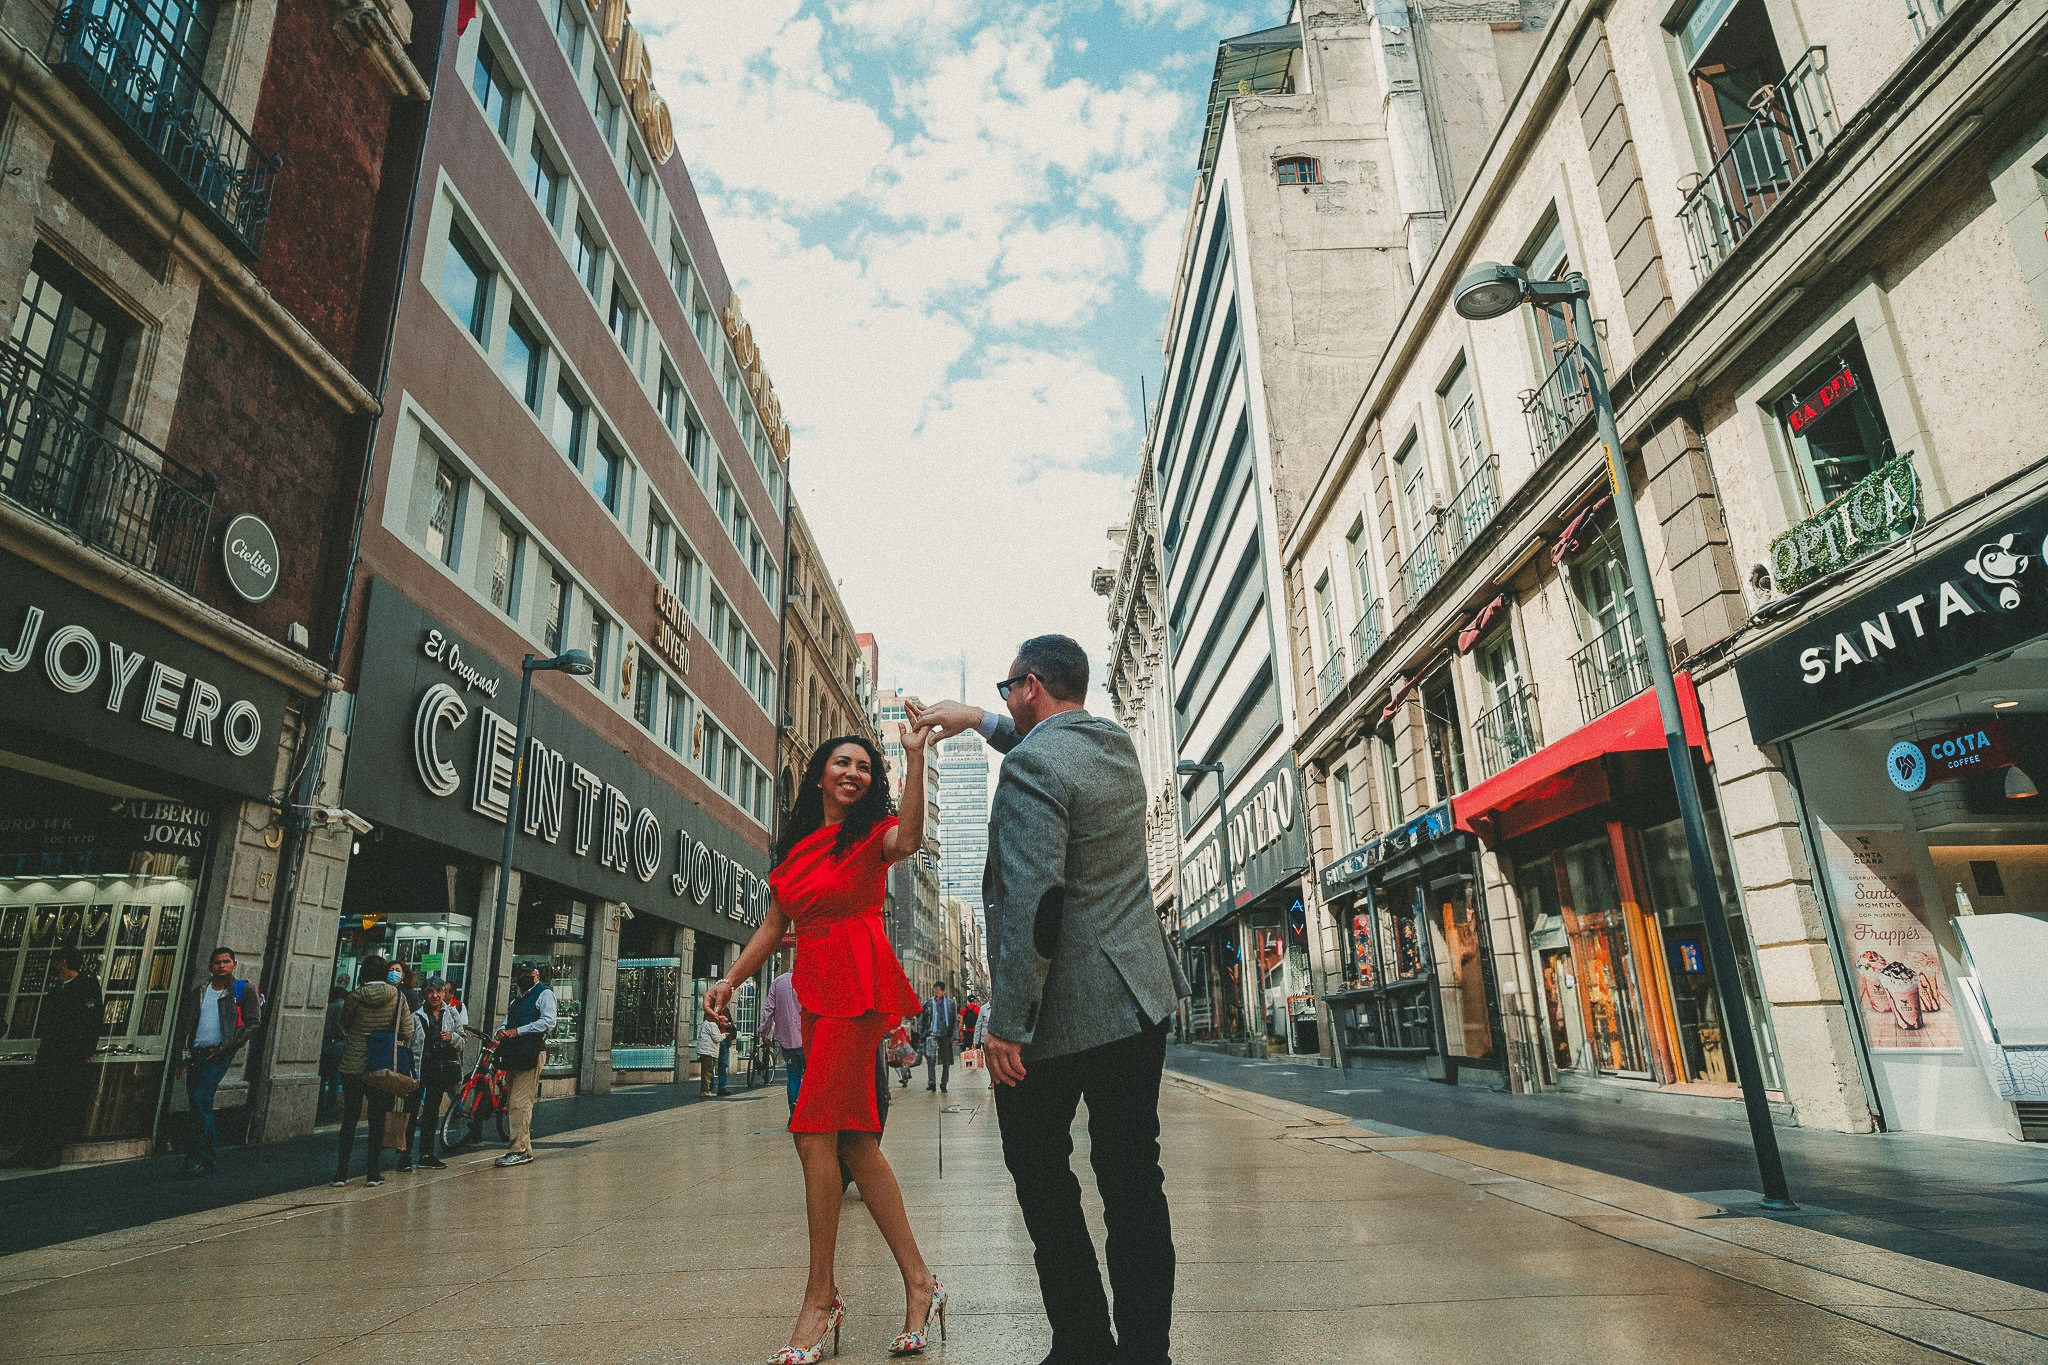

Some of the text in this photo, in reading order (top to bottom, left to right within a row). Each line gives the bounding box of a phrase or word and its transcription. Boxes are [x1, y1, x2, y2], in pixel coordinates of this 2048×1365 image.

[231, 538, 272, 574] Cielito
[657, 583, 692, 642] CENTRO
[424, 628, 447, 663] El
[655, 619, 690, 676] JOYERO
[1799, 581, 1976, 685] SANTA
[0, 605, 262, 757] JOYERO
[1931, 731, 1991, 760] COSTA
[1947, 754, 1981, 769] COFFEE
[414, 682, 772, 929] CENTRO JOYERO
[1226, 767, 1294, 874] JOYERO
[143, 825, 202, 848] JOYAS
[259, 871, 275, 889] 57
[1854, 883, 1900, 900] Santo
[1853, 922, 1921, 946] Frappés
